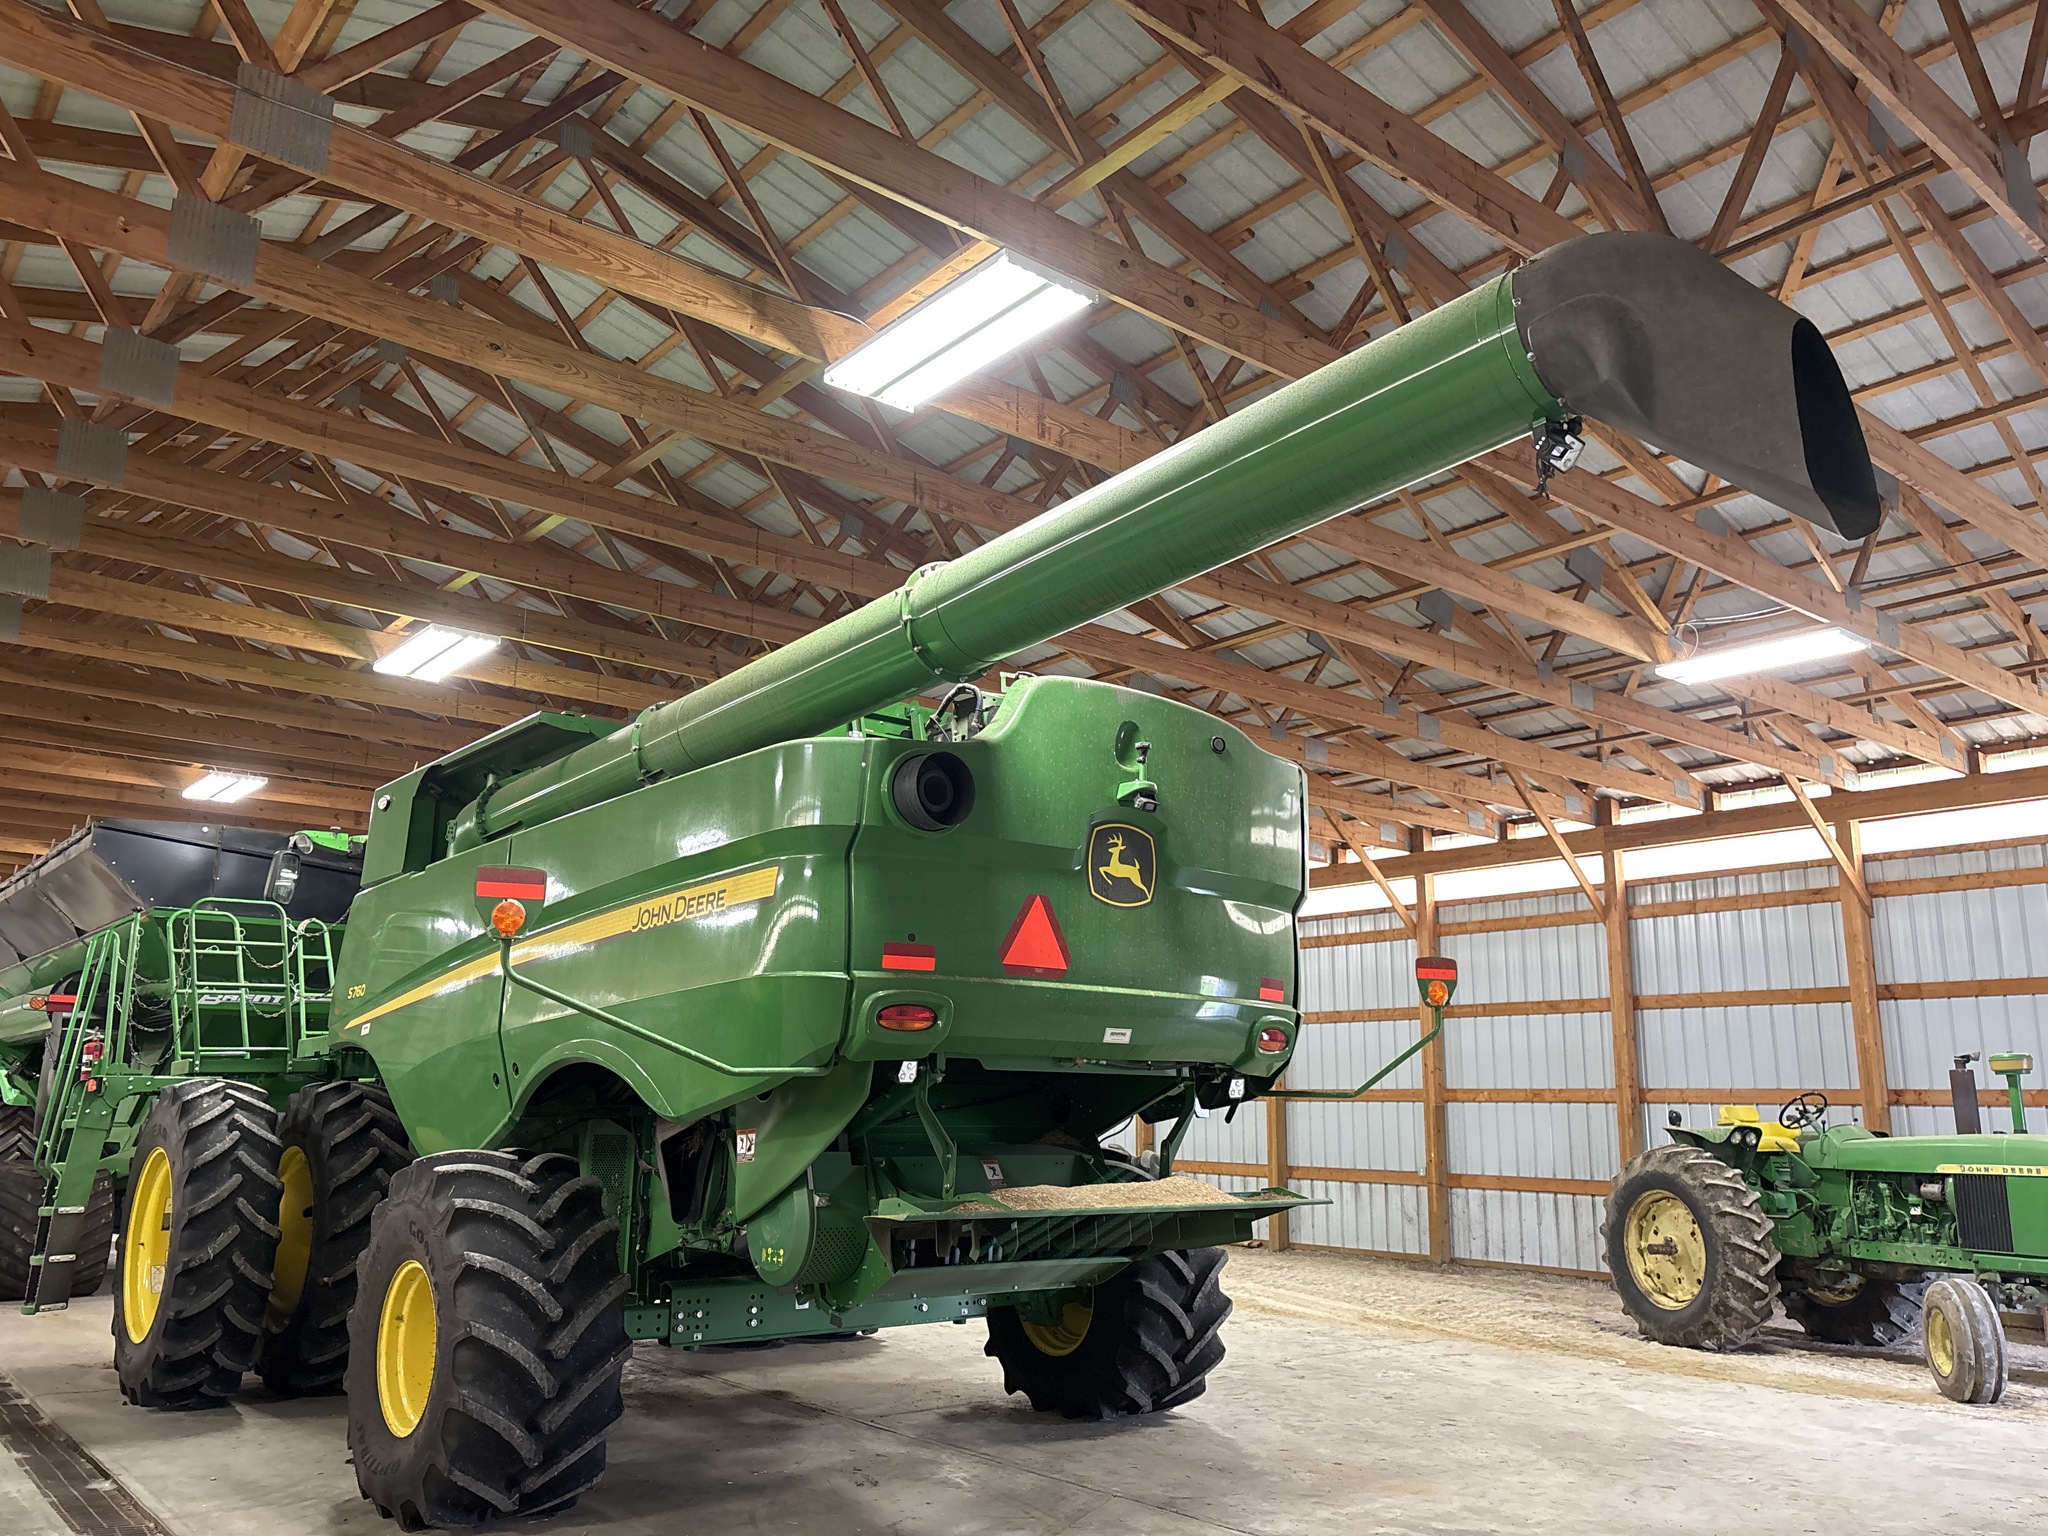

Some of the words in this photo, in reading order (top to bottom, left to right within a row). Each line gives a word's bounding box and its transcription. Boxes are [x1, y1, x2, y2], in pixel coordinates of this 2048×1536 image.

[631, 903, 673, 930] JOHN
[674, 889, 727, 919] DEERE
[347, 983, 366, 1000] S760
[1960, 1165, 1990, 1174] JOHN
[2002, 1166, 2042, 1175] DEERE
